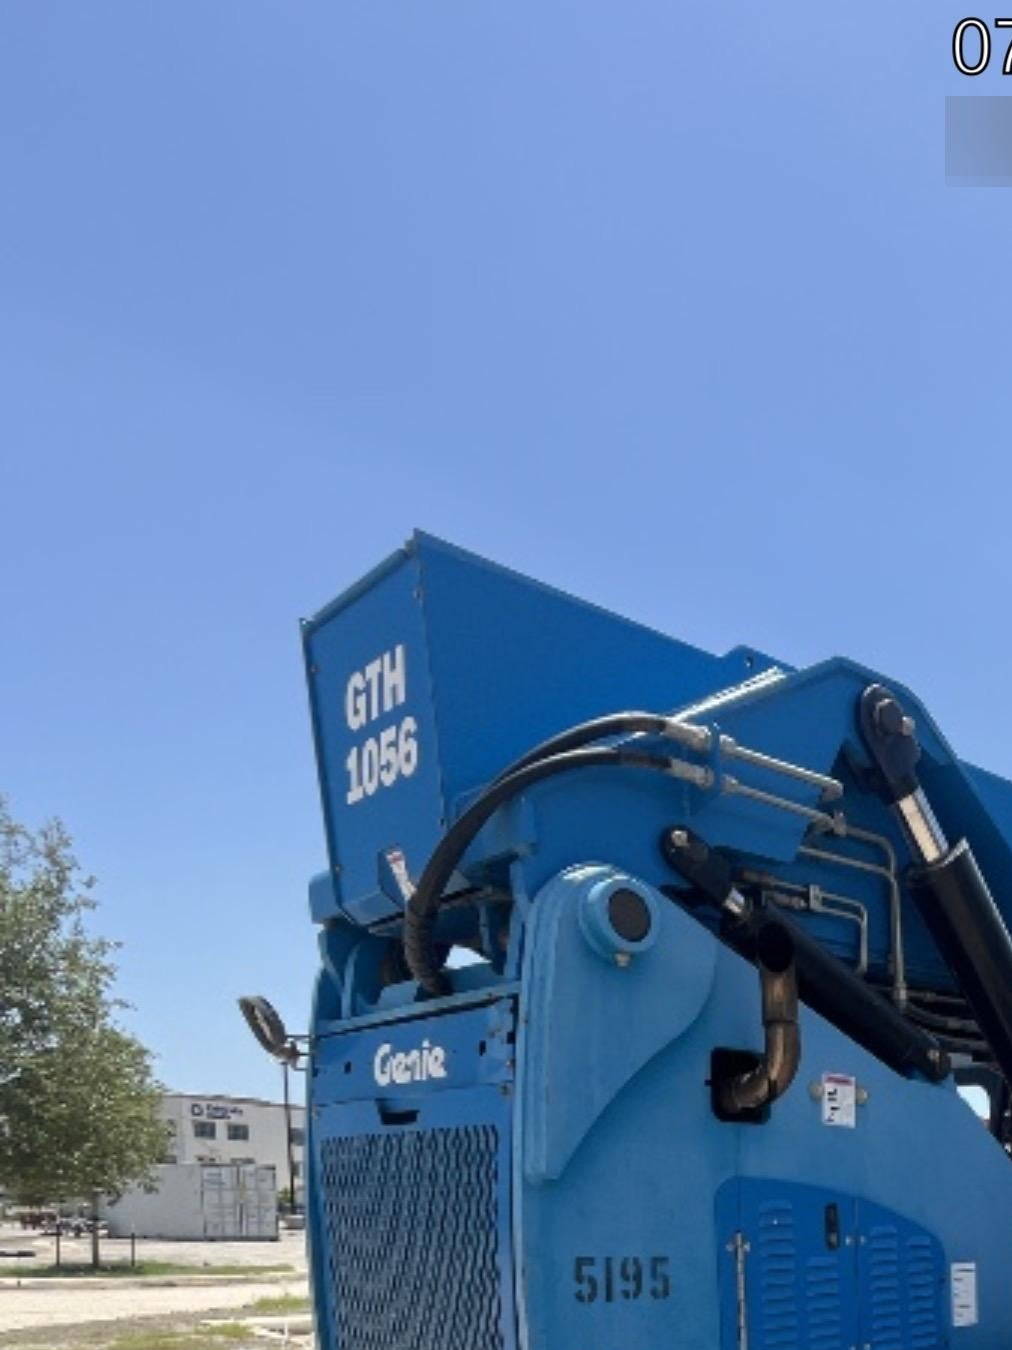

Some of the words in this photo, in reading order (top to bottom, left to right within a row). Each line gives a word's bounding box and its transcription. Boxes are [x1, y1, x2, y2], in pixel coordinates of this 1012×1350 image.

[346, 645, 406, 730] GTH
[346, 716, 418, 805] 1056
[374, 1039, 447, 1087] Genie
[574, 1256, 670, 1303] 5195
